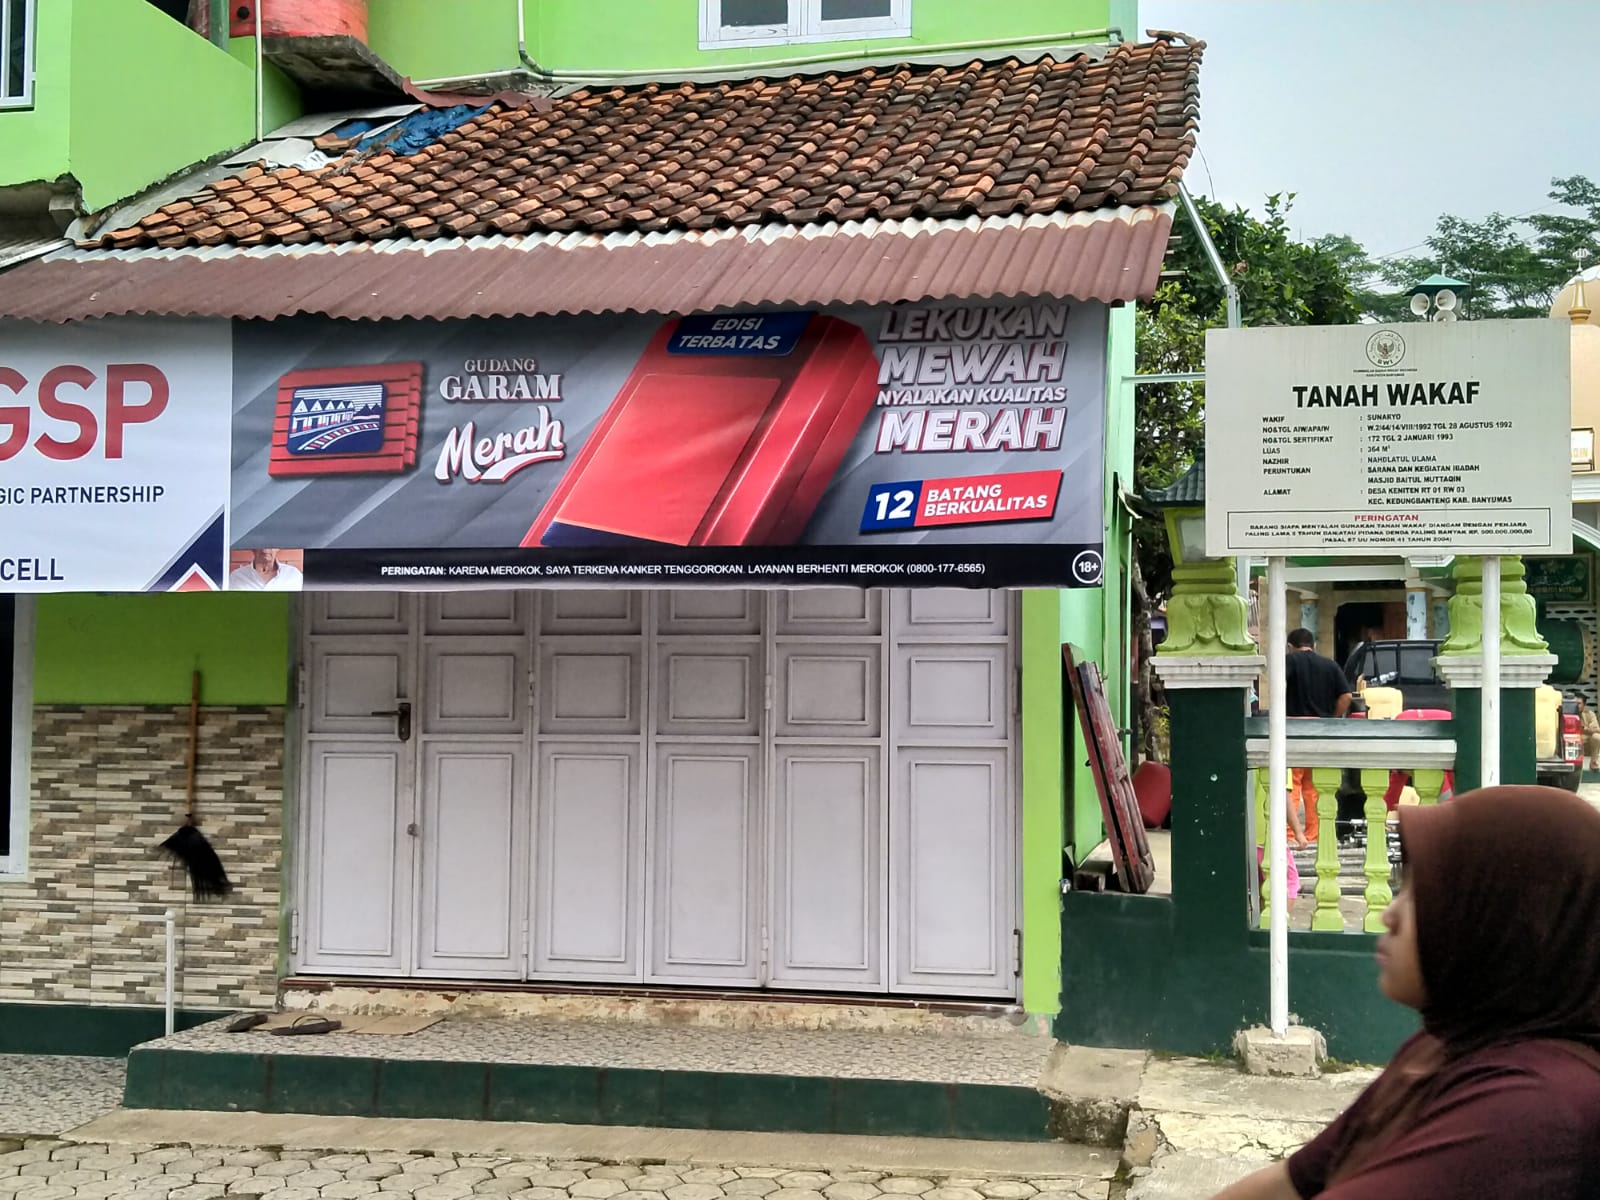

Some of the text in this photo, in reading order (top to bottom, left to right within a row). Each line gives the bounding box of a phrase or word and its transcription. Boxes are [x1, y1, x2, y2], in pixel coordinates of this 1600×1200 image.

[711, 318, 764, 332] EDISI
[879, 305, 1068, 343] LEKUKAN
[679, 335, 781, 350] TERBATAS
[464, 358, 536, 373] GUDANG
[877, 343, 1067, 386] MEWAH
[439, 374, 562, 401] GARAM
[1292, 381, 1481, 408] TANAH WAKAF
[877, 386, 1067, 407] NYALAKAN KUALITAS
[1367, 413, 1402, 421] SUNARYO
[1433, 422, 1447, 430] TGL
[1459, 421, 1494, 429] AGUSTUS
[875, 408, 1067, 454] MERAH
[1382, 434, 1395, 442] TGL
[1397, 434, 1402, 442] 2
[434, 405, 565, 483] Merah
[1263, 467, 1311, 475] PERUNTUKAN
[1414, 465, 1451, 473] KEGIATAN
[30, 485, 165, 504] PARTNERSHIP
[1367, 487, 1387, 495] DESA
[874, 484, 1002, 521] 12 BATANG
[923, 495, 1048, 518] BERKUALITAS
[1386, 497, 1451, 505] KEDUNGBANTENG
[1471, 495, 1513, 503] BANYUMAS
[0, 558, 64, 581] CELL
[381, 566, 448, 576] PERINGATAN:
[448, 566, 489, 576] KARENA
[490, 565, 544, 577] MEROKOK,
[545, 565, 571, 575] SAYA
[572, 565, 619, 575] TERKENA
[620, 564, 662, 575] KANKER
[748, 564, 794, 574] LAYANAN
[796, 564, 849, 574] BERHENTI
[850, 563, 905, 574] MEROKOK
[906, 563, 986, 575] (0800-177-6565)
[1078, 560, 1099, 573] 18+
